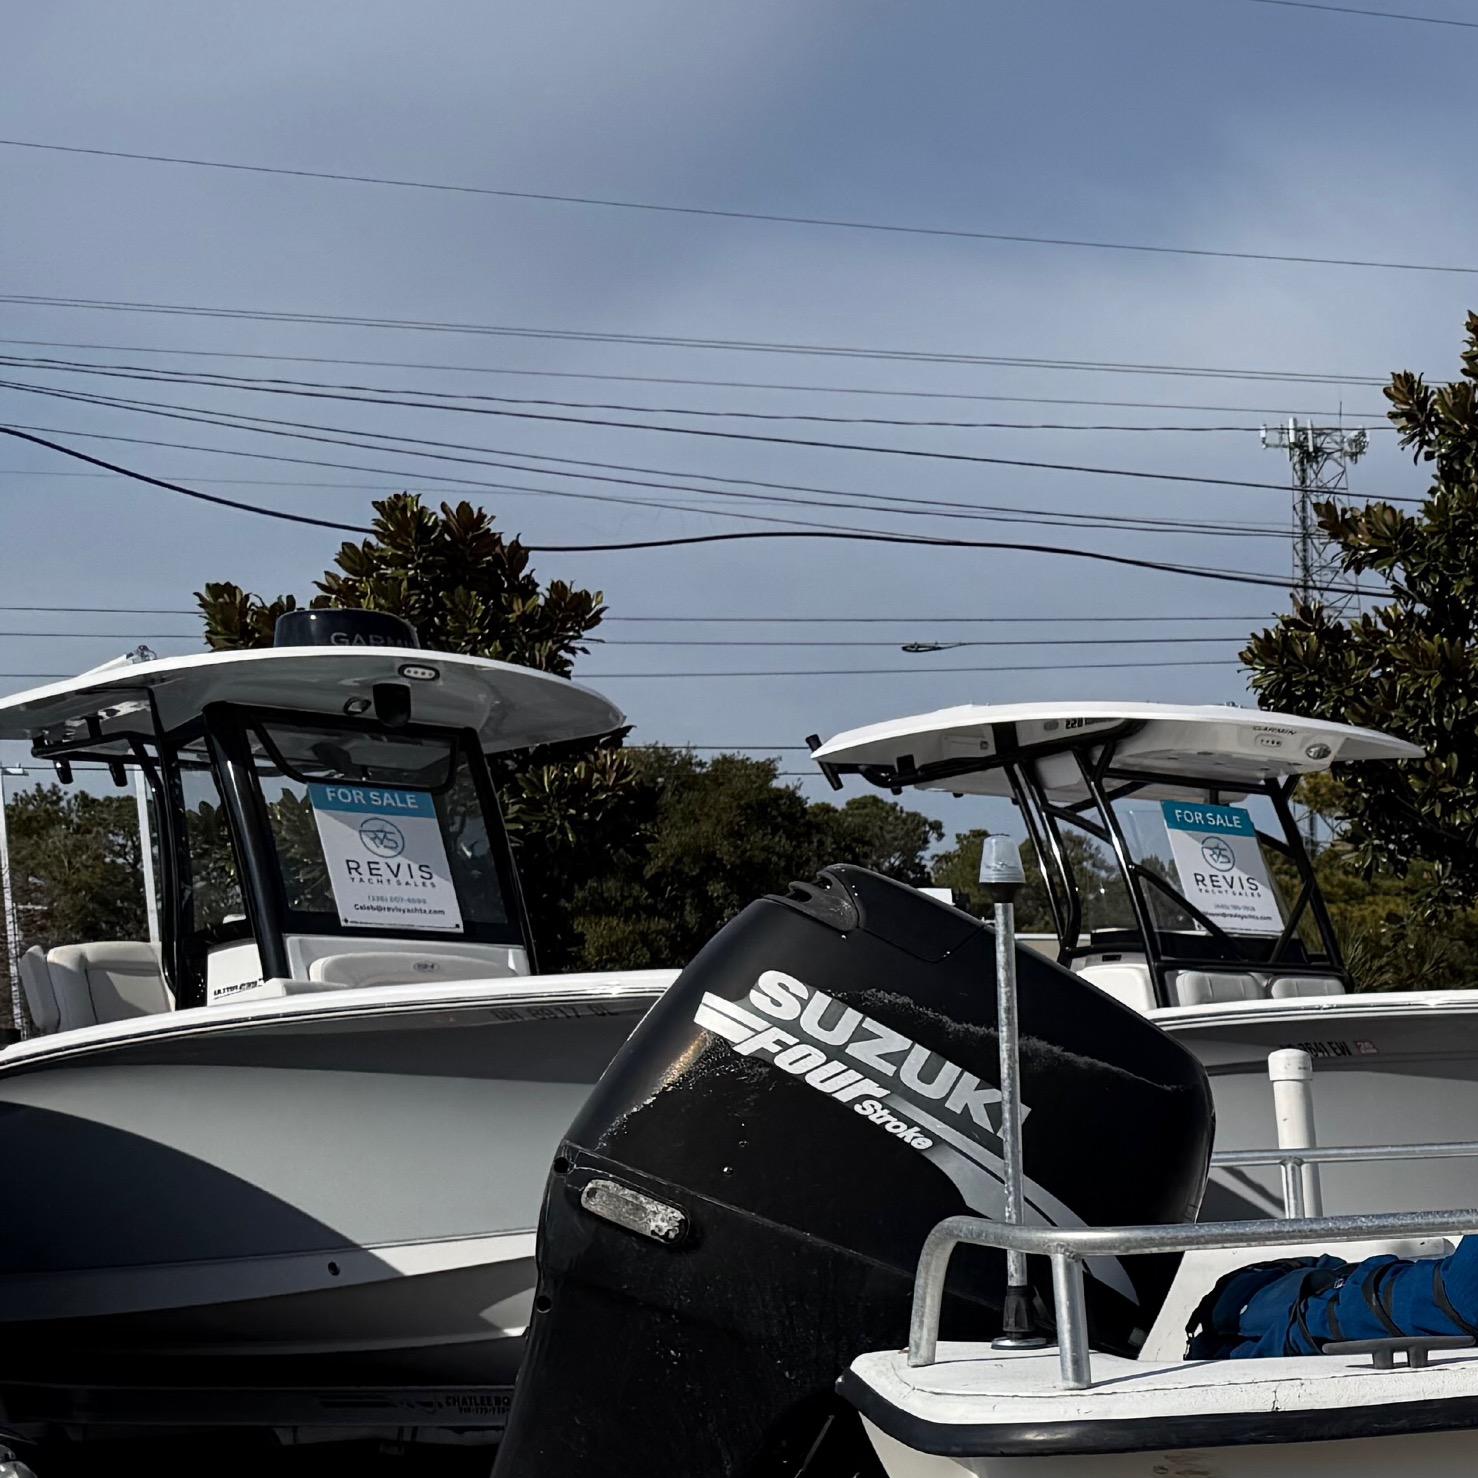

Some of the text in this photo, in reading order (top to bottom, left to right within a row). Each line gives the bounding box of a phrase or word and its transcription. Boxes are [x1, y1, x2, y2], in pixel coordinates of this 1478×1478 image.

[325, 787, 419, 809] FOR SALE
[1175, 809, 1243, 829] FOR SALE
[346, 859, 434, 881] REVIS
[1193, 872, 1260, 892] REVIS
[853, 1099, 934, 1150] Stroke
